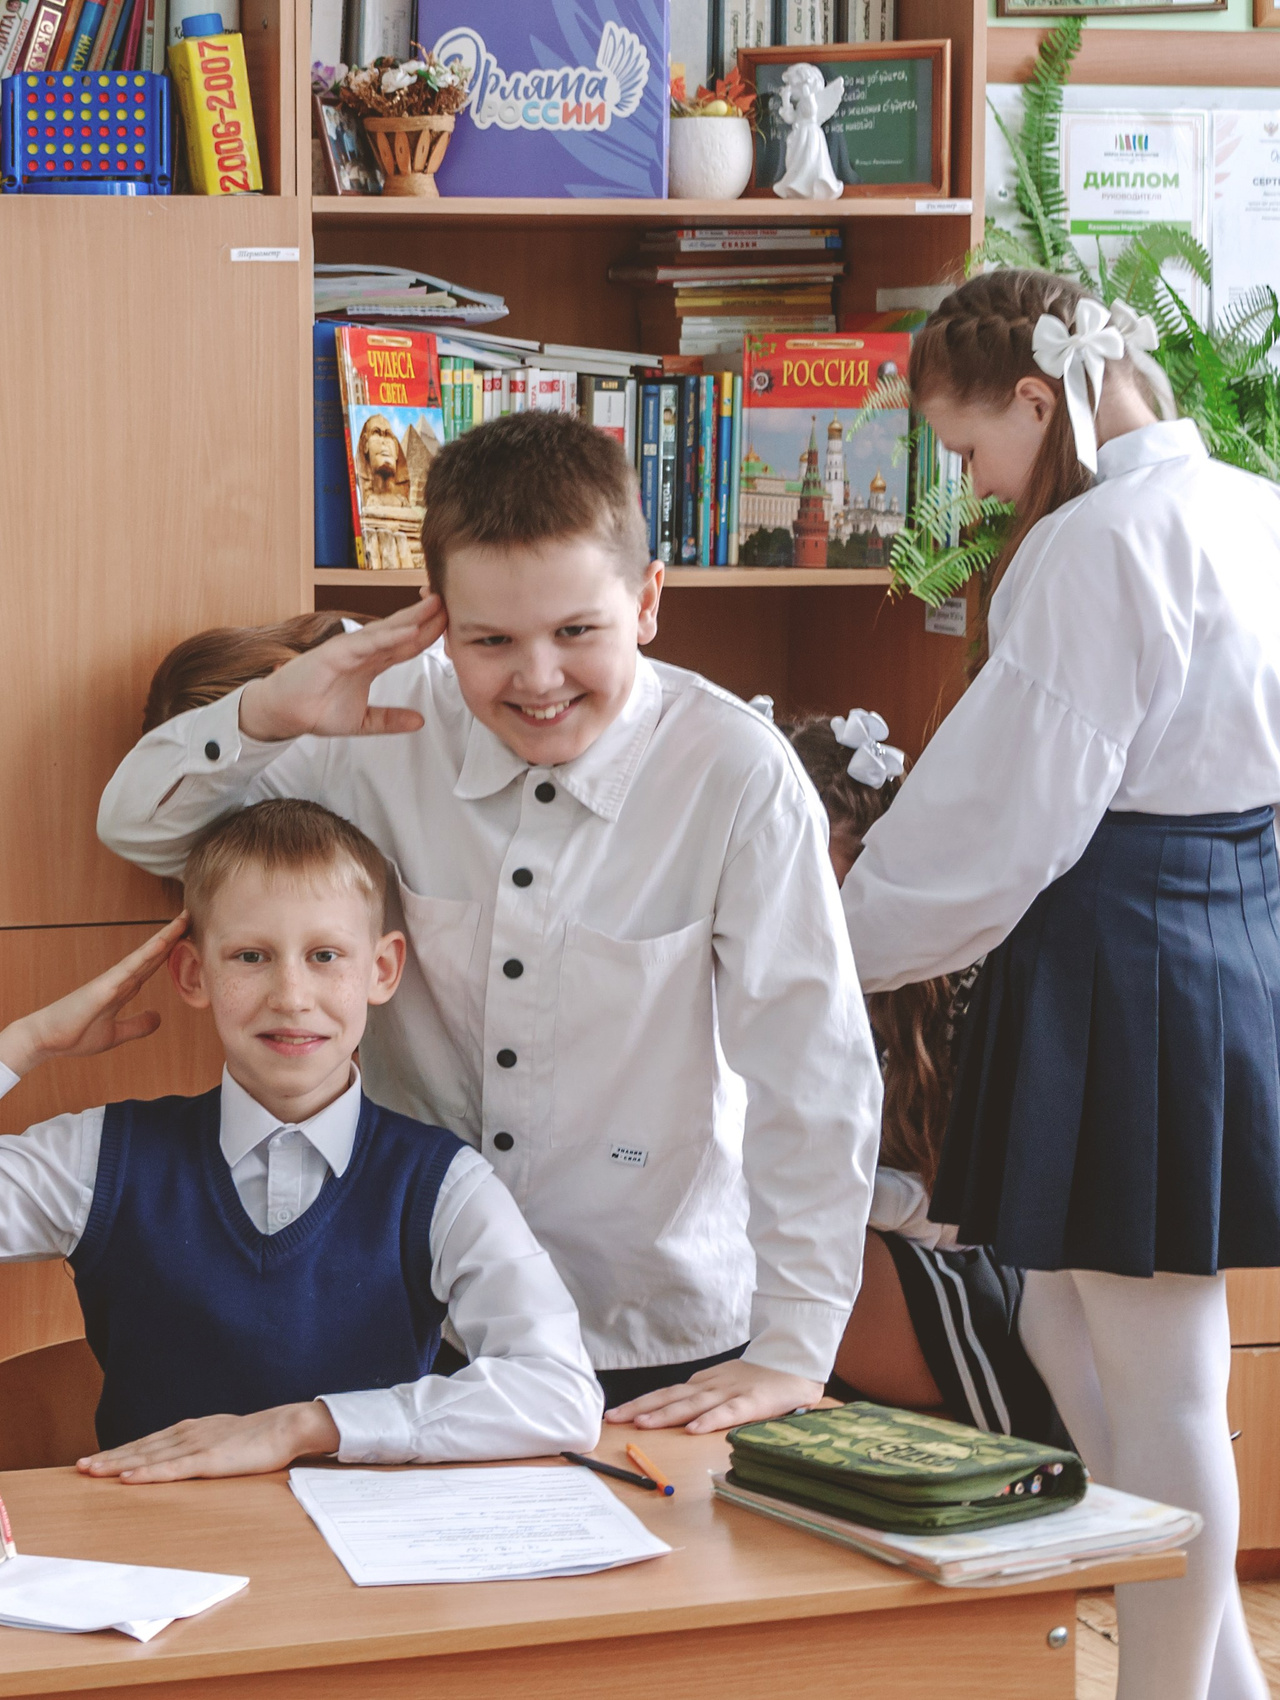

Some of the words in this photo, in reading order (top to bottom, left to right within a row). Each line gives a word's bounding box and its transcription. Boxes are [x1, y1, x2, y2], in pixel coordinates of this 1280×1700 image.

[7, 18, 29, 71] МИКРОСКОП
[28, 20, 54, 72] СКАЗ
[437, 33, 608, 114] Орлята
[197, 41, 250, 192] 2006-2007
[479, 101, 606, 125] РОССИИ
[1083, 171, 1179, 190] ДИПЛОМ
[1101, 193, 1161, 201] РУКОВОДИТЕЛЯ
[237, 250, 281, 259] Термометр
[367, 350, 415, 380] ЧУДЕСА
[782, 358, 869, 387] РОССИЯ
[380, 382, 408, 404] СВЕТА
